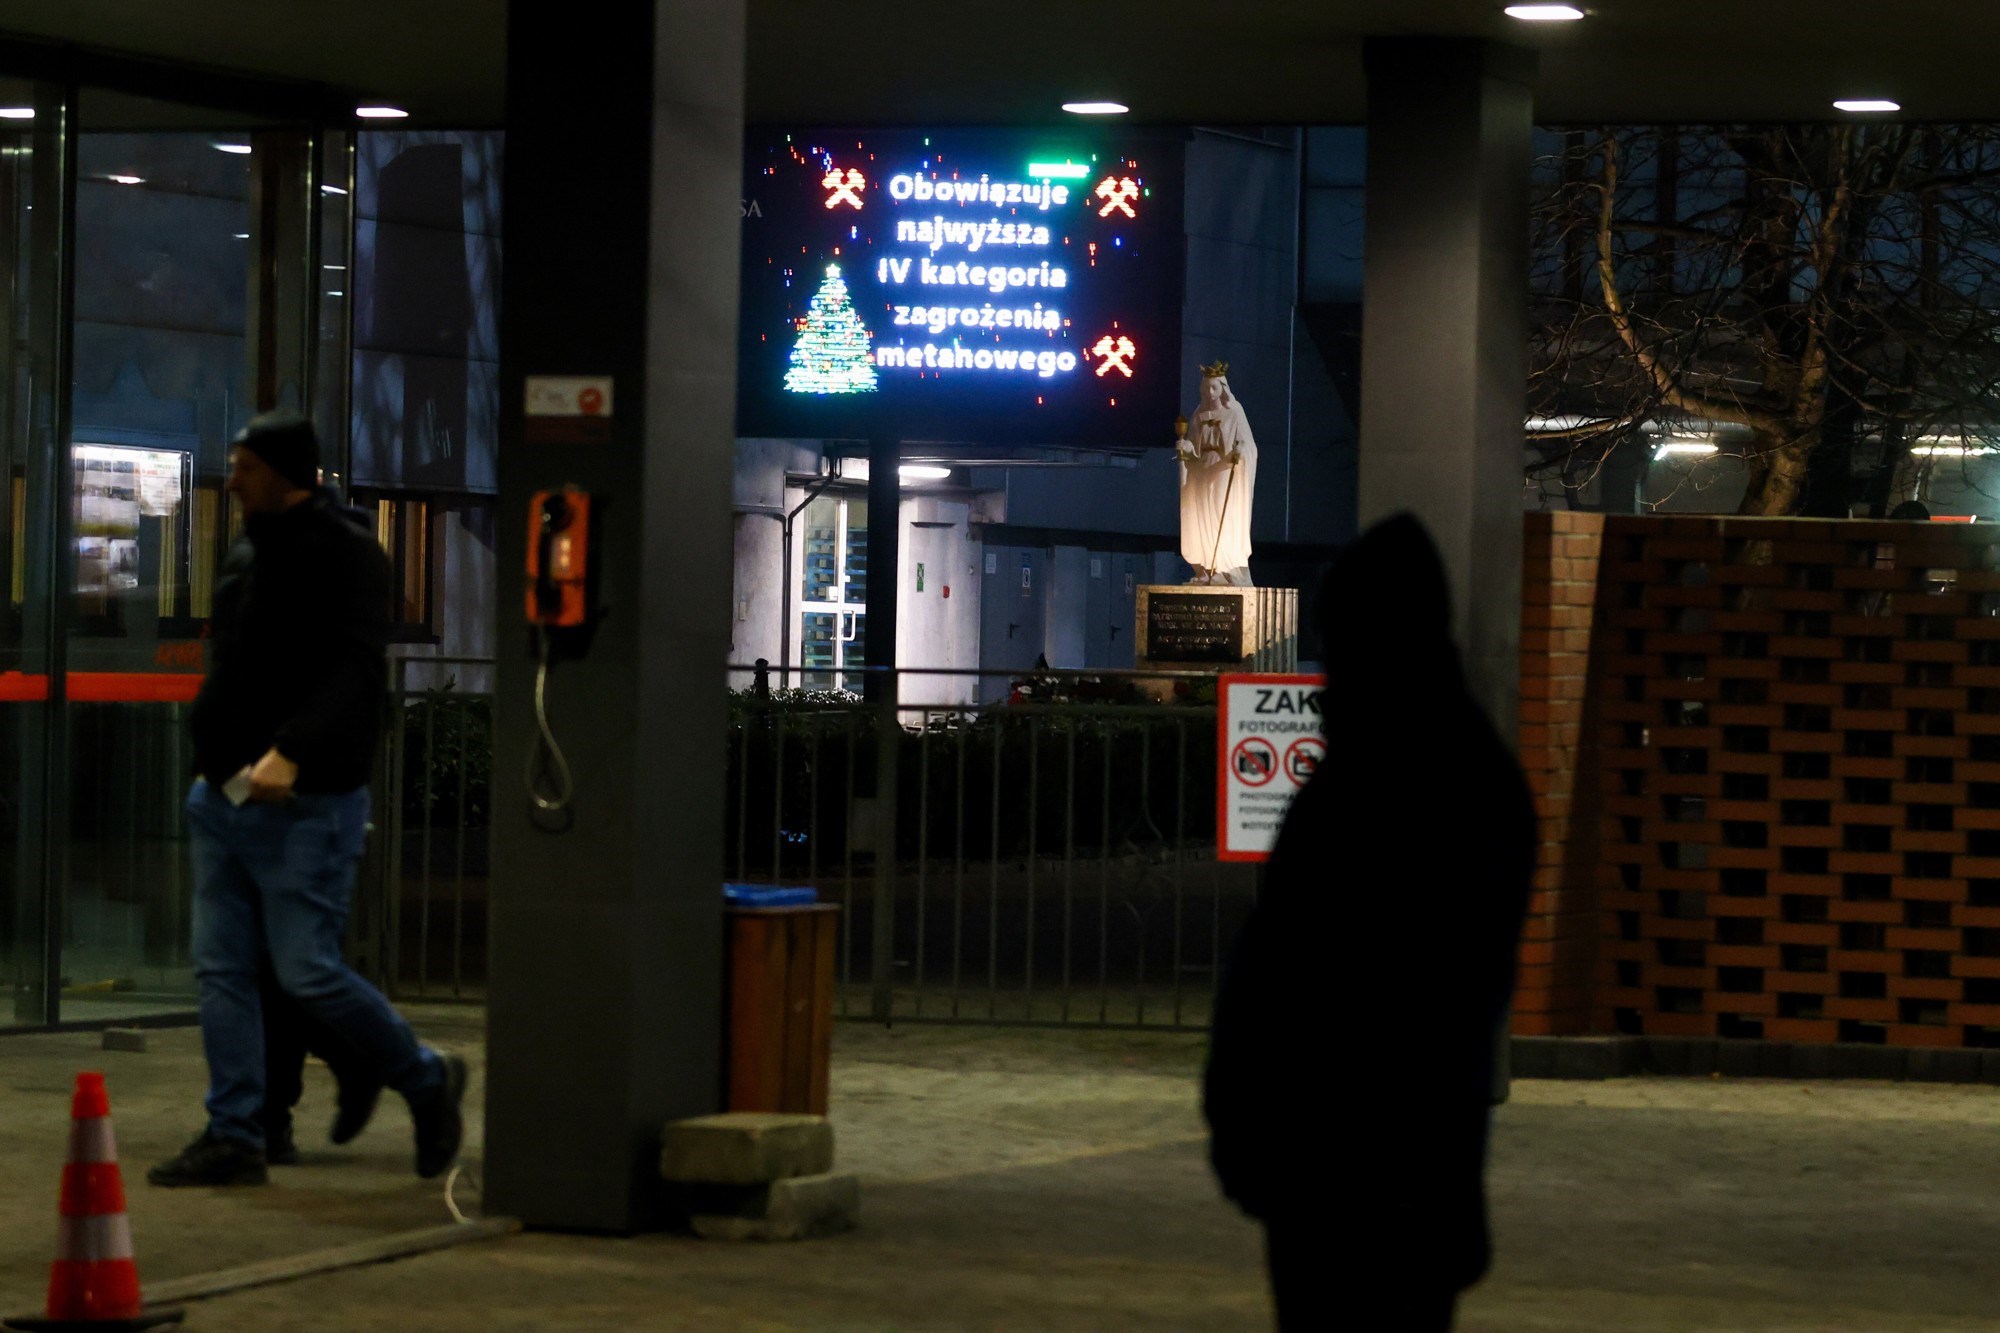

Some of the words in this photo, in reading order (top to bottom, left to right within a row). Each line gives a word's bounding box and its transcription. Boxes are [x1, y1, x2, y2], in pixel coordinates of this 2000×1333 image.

[889, 172, 1070, 210] Obowiązuje
[897, 215, 1050, 252] najwyższa
[878, 257, 912, 284] IV
[921, 257, 1067, 292] kategoria
[893, 302, 1060, 334] zagrożenia
